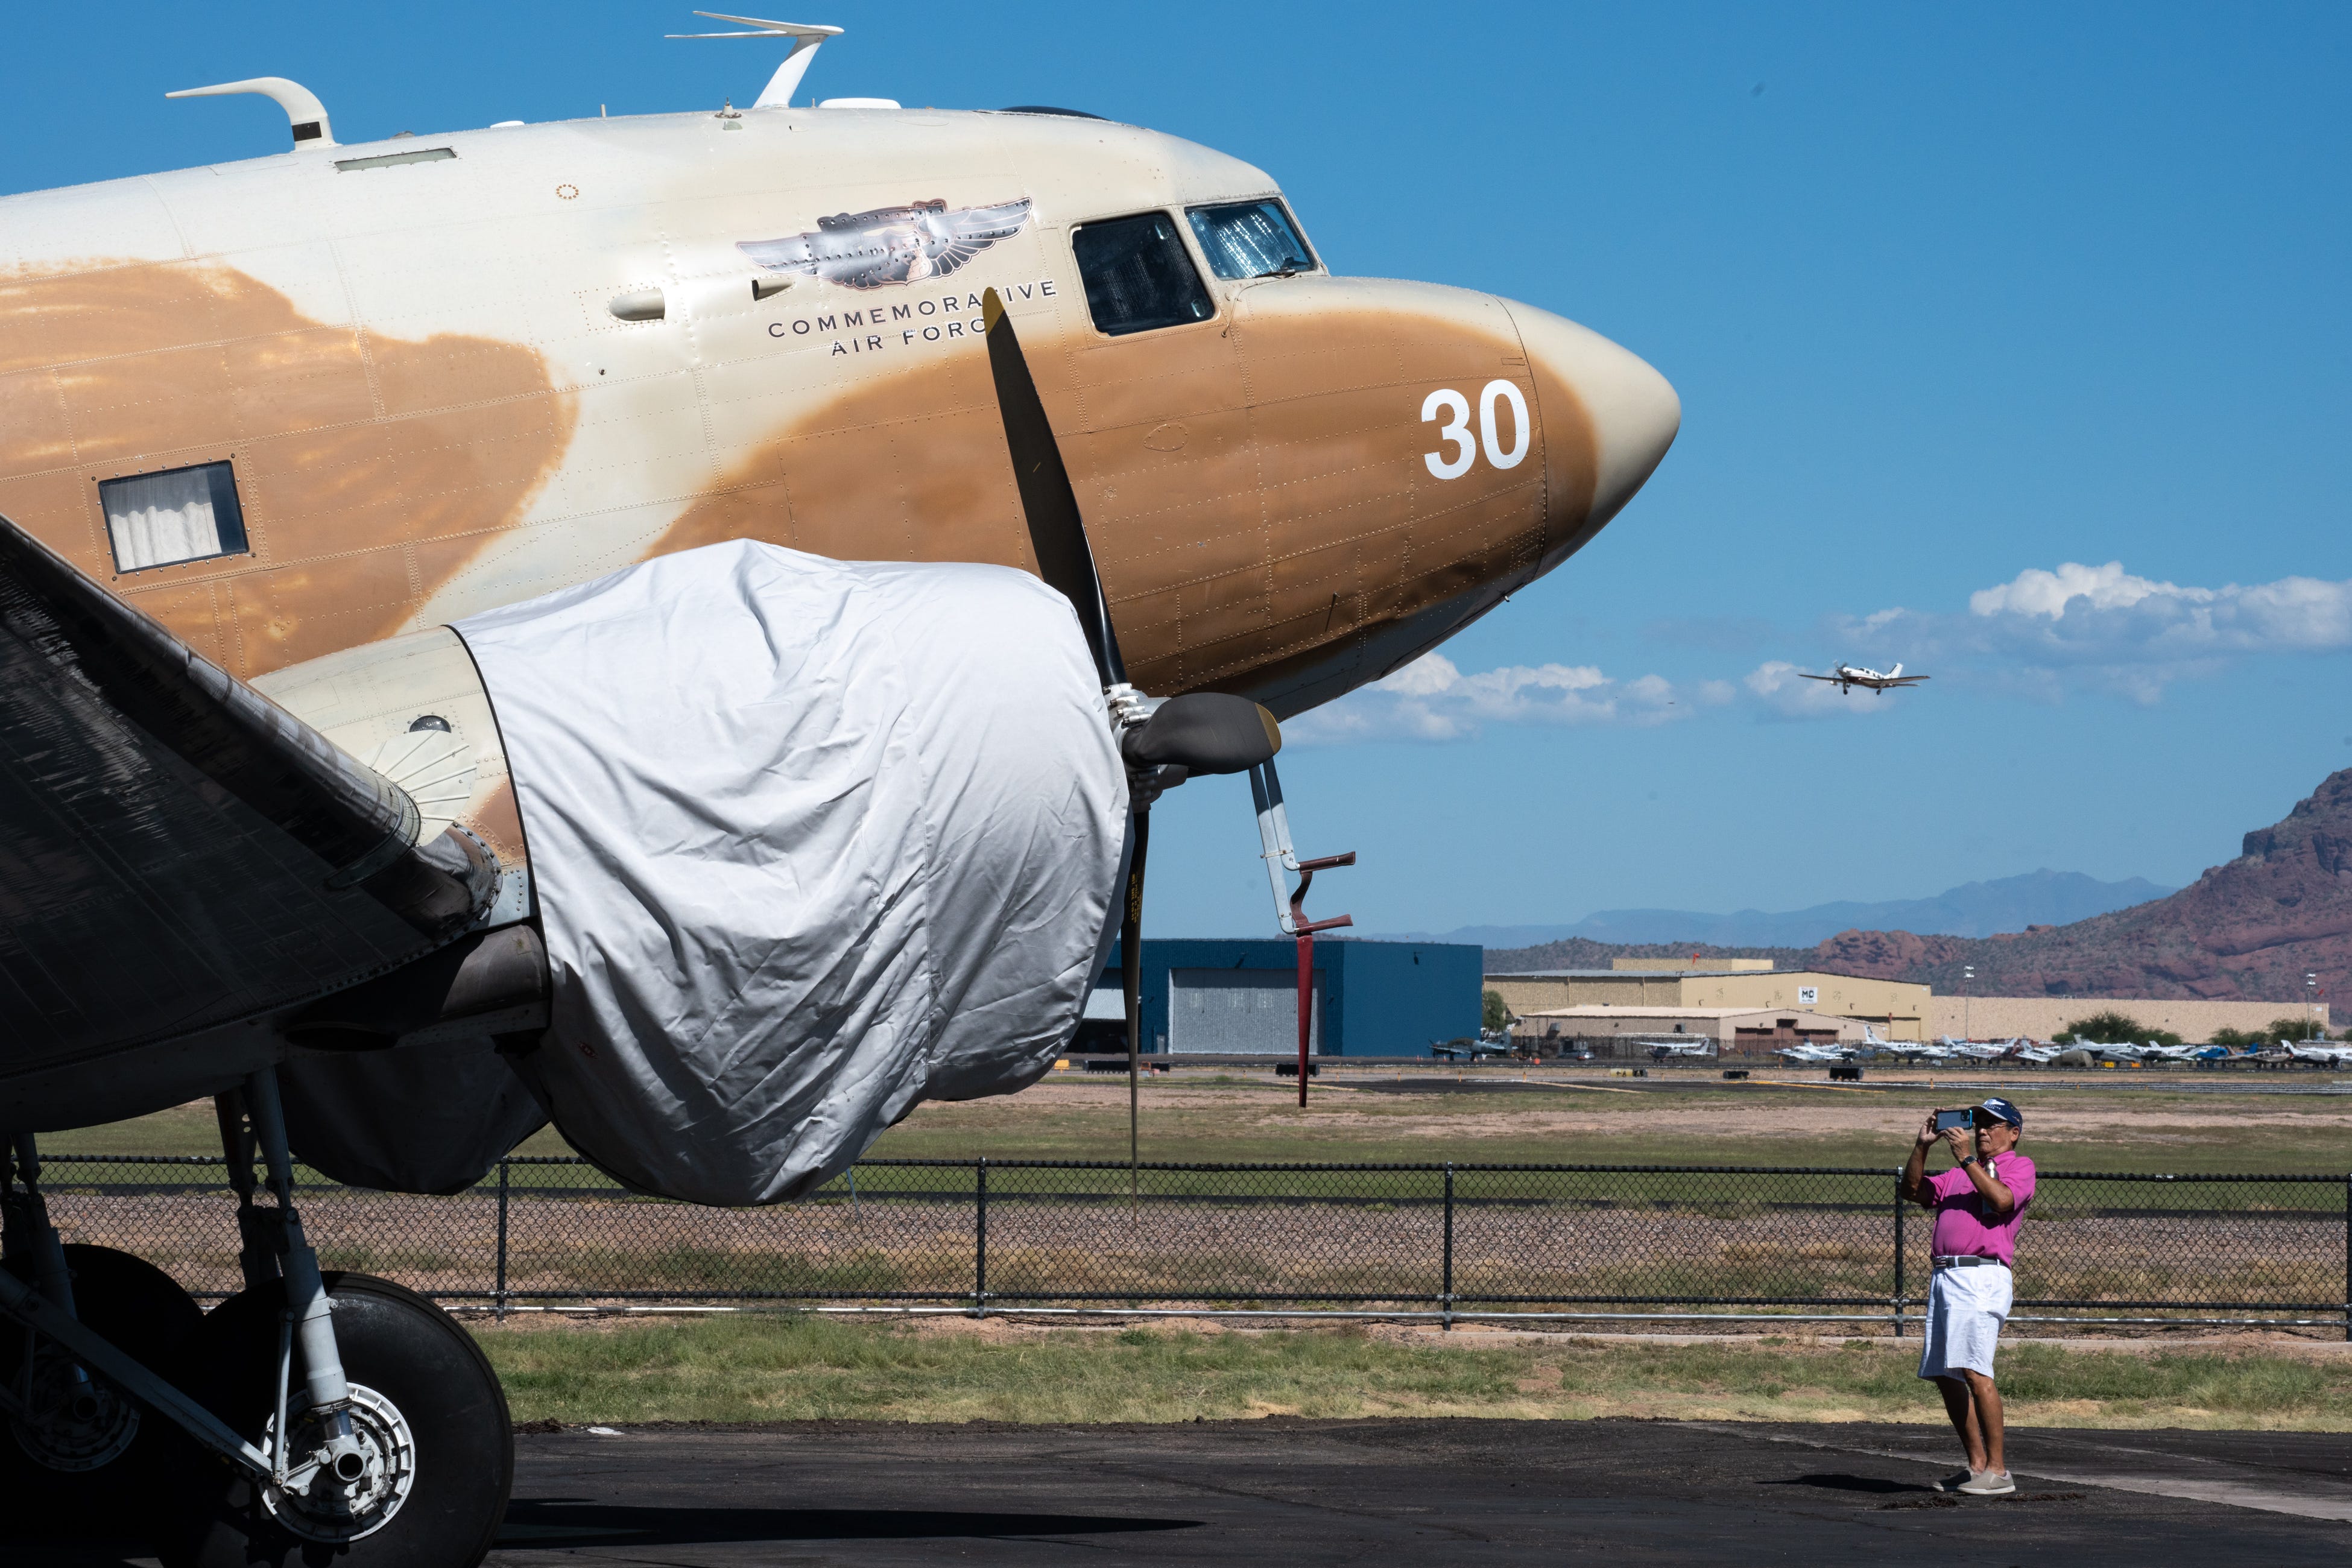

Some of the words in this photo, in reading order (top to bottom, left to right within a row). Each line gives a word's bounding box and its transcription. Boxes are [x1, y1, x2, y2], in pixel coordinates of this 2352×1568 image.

[768, 280, 1055, 338] COMMEMORAIVE
[832, 335, 884, 356] AIR
[902, 317, 985, 345] FORC
[1421, 379, 1530, 479] 30
